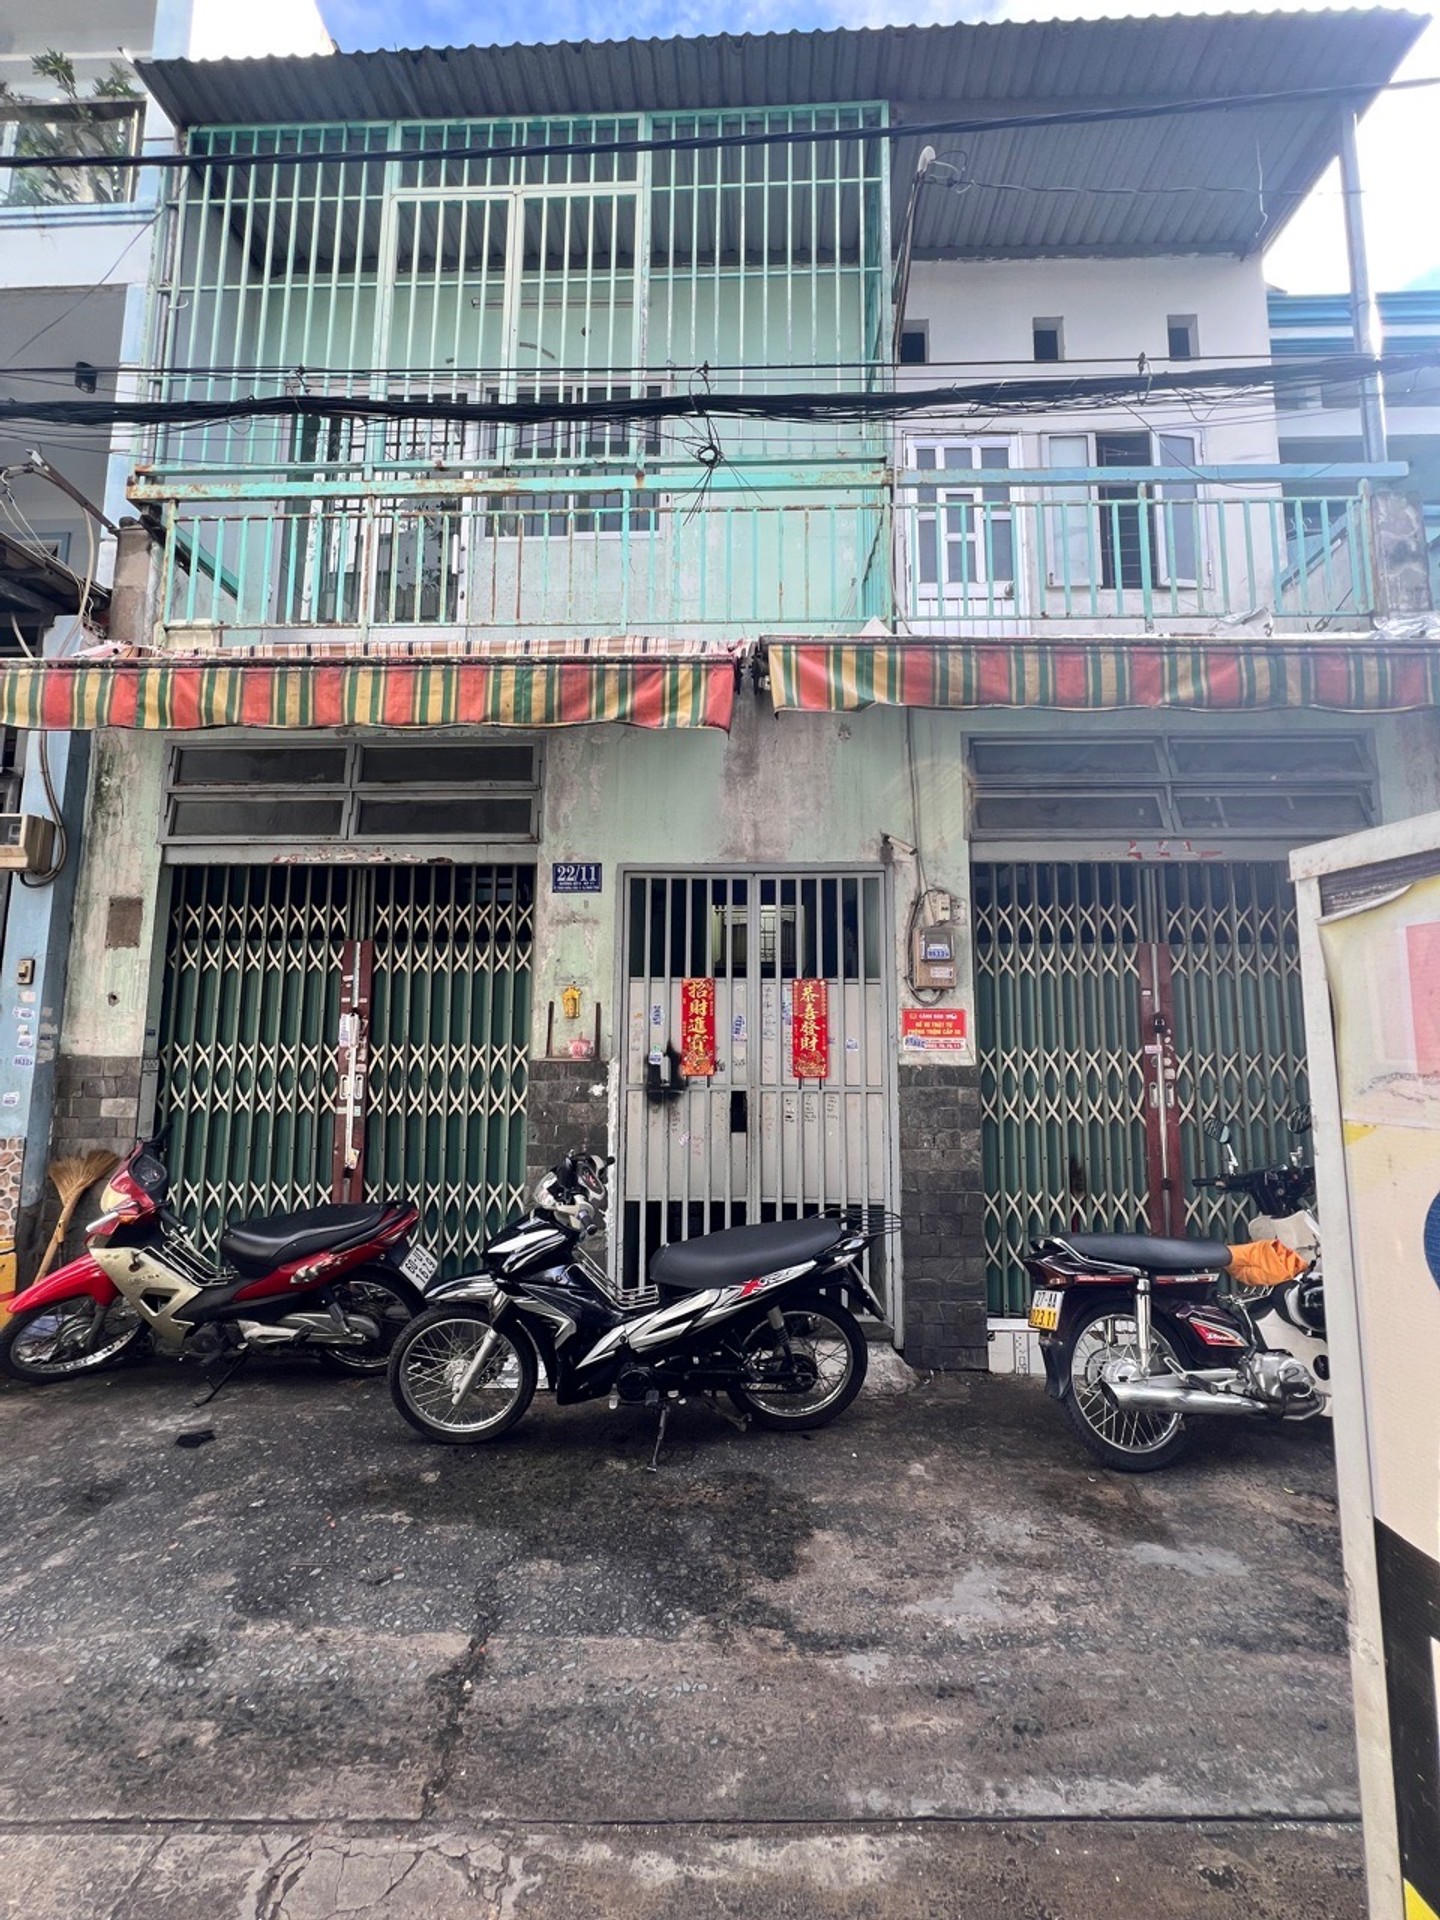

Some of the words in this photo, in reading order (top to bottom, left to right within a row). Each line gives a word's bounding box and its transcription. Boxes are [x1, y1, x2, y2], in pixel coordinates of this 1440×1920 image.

[557, 864, 596, 881] 22/11
[687, 981, 709, 1056] 招財進寶
[800, 983, 821, 1051] 恭喜發財
